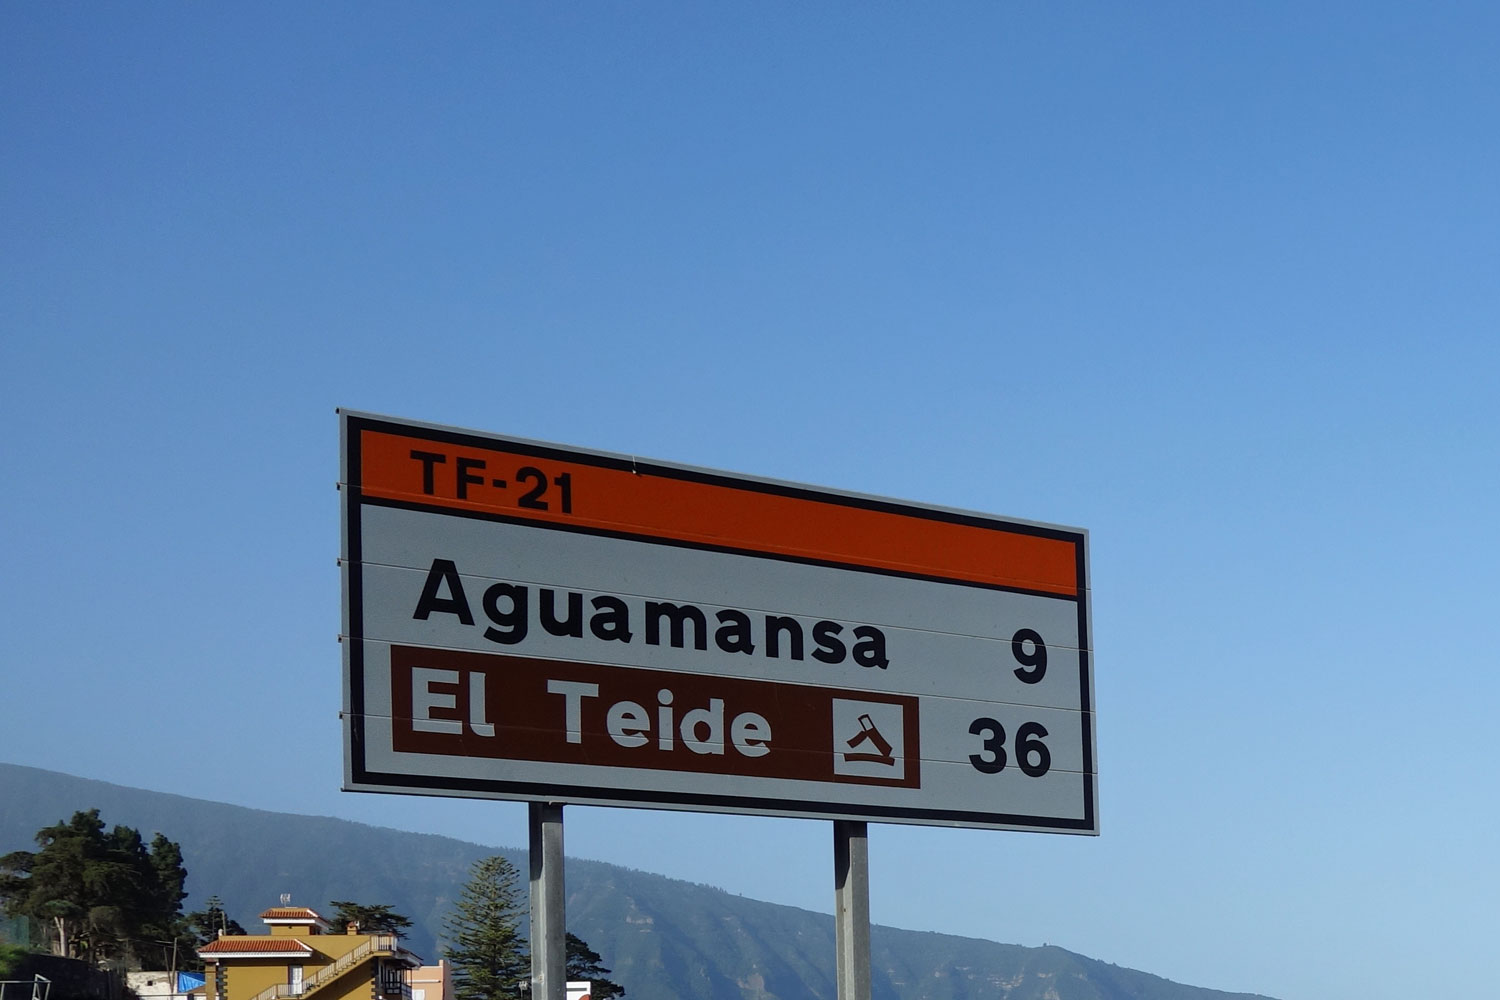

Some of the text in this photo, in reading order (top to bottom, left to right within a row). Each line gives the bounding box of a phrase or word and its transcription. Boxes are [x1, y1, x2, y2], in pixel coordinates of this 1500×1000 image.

[412, 452, 572, 513] TF-21
[413, 558, 1048, 684] Aguamansa 9
[411, 667, 1051, 778] El Teide 36
